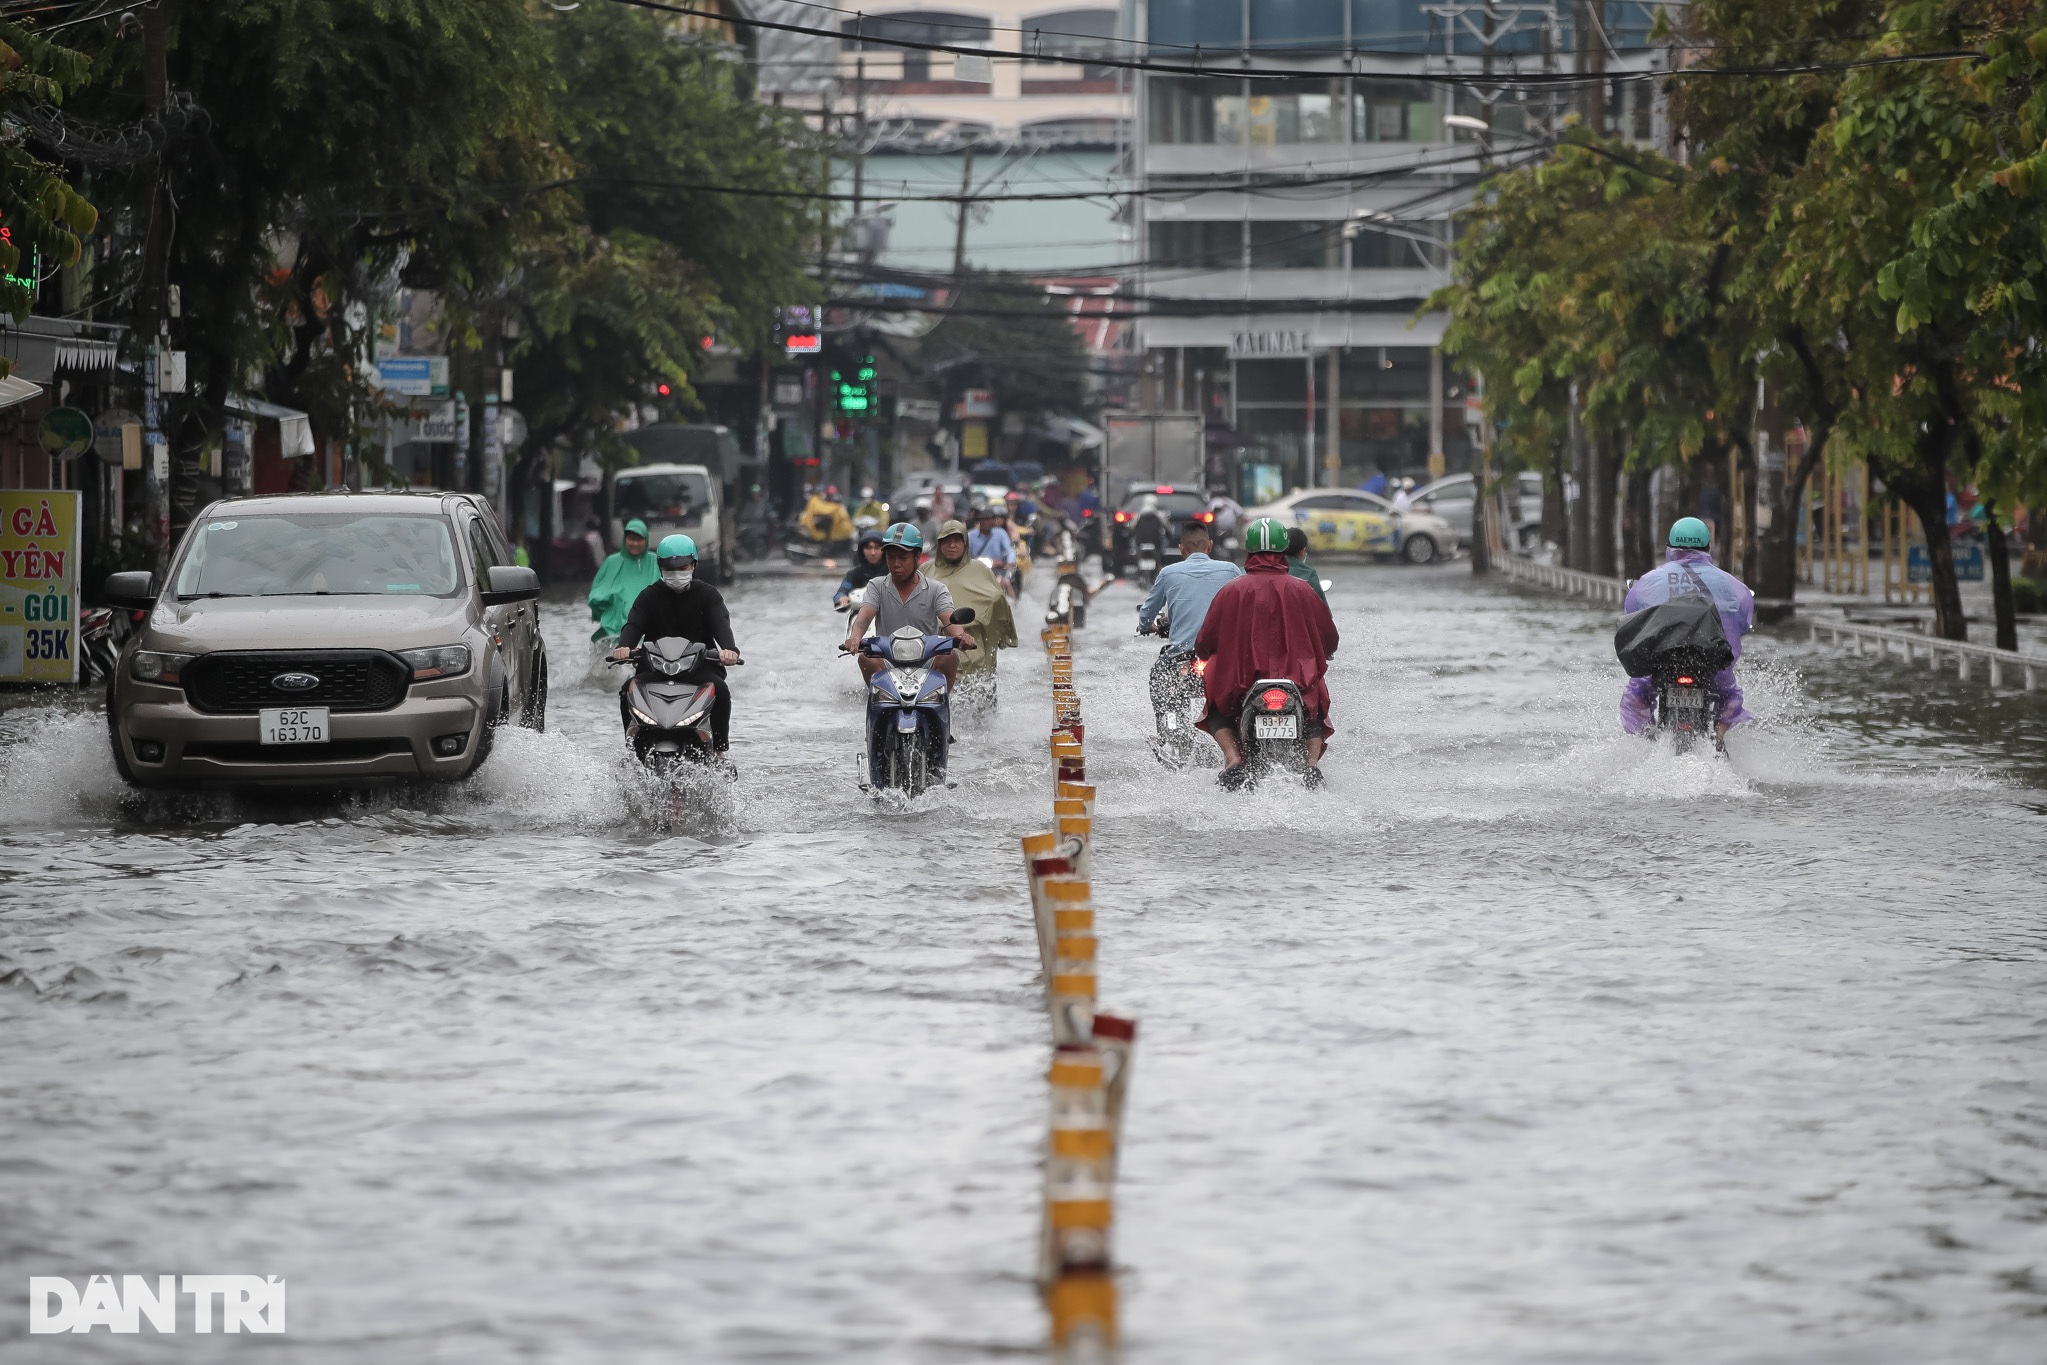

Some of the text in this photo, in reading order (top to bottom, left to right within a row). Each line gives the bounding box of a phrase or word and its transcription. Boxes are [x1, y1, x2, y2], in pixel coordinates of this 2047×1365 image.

[1230, 331, 1306, 353] KATINAT
[11, 500, 58, 537] GÀ
[1675, 536, 1702, 544] BAEMIN
[24, 585, 68, 622] GỎI
[26, 629, 69, 660] 35K
[282, 675, 309, 687] Ford
[280, 711, 309, 725] 62C
[270, 727, 322, 741] 163.70
[1259, 727, 1294, 737] 077.75
